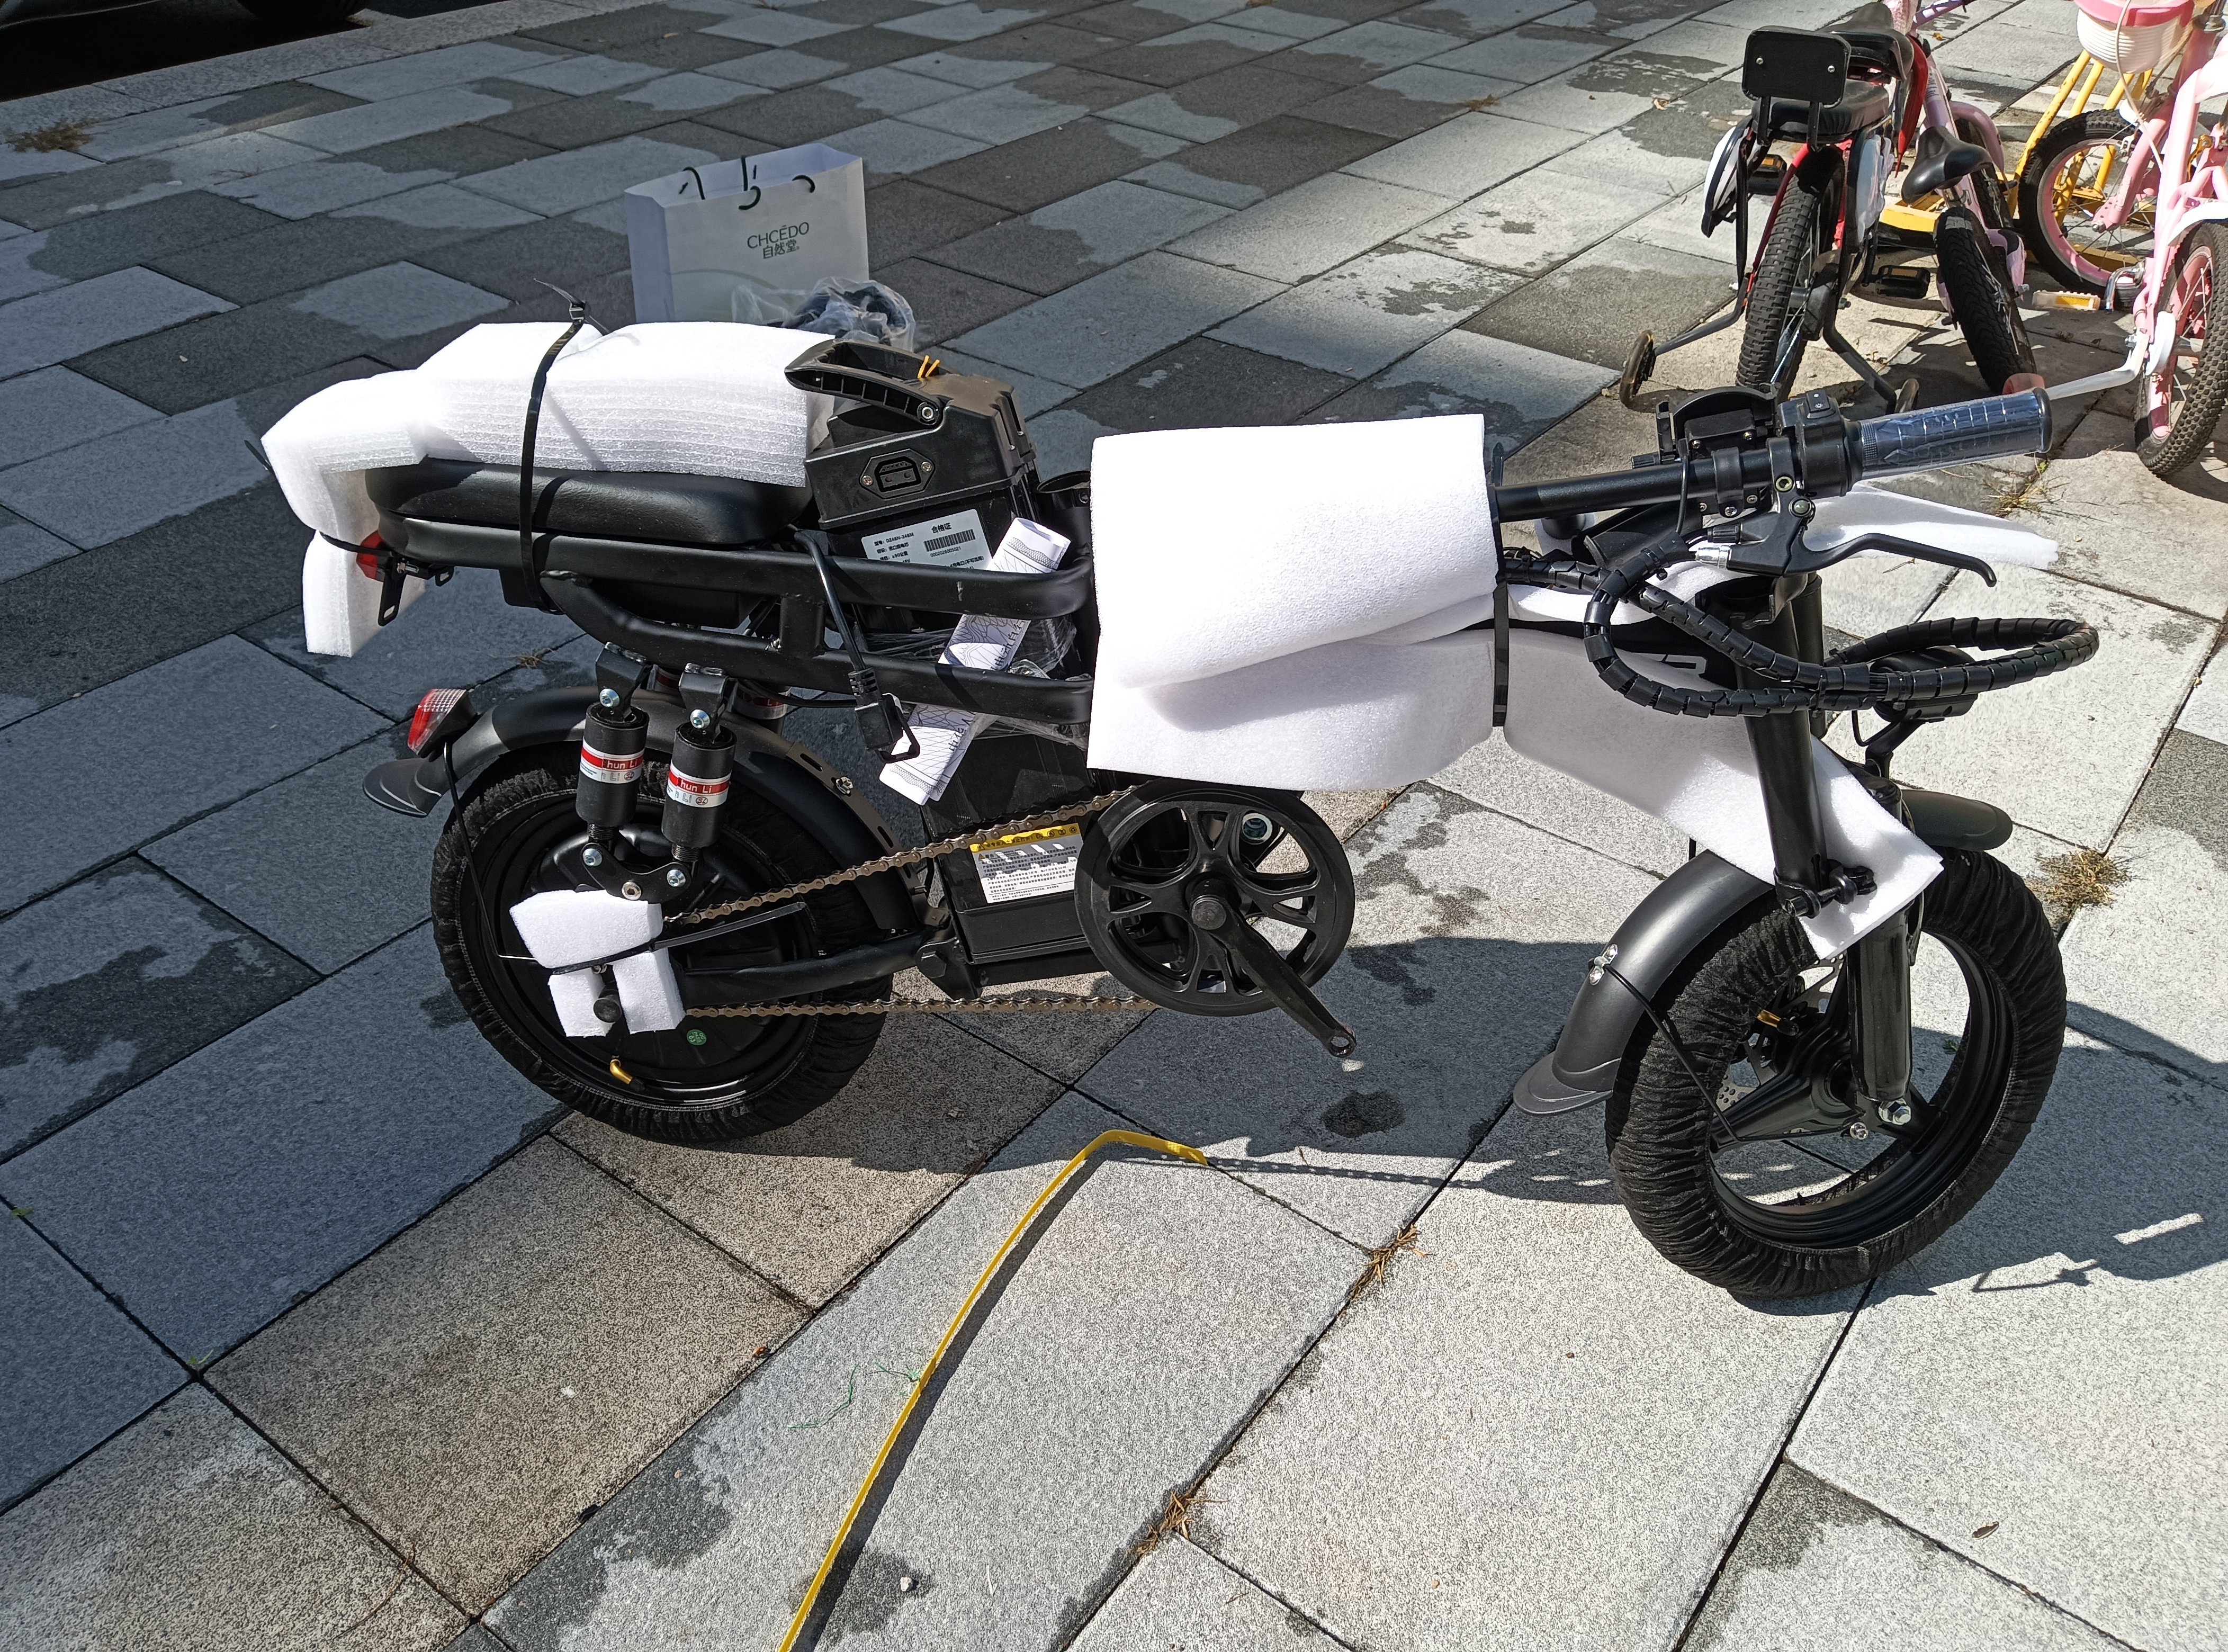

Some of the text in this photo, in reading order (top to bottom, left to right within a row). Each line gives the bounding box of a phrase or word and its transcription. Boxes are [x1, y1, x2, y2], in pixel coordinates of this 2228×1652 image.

[762, 239, 797, 259] 自然堂
[931, 522, 952, 534] 合格证
